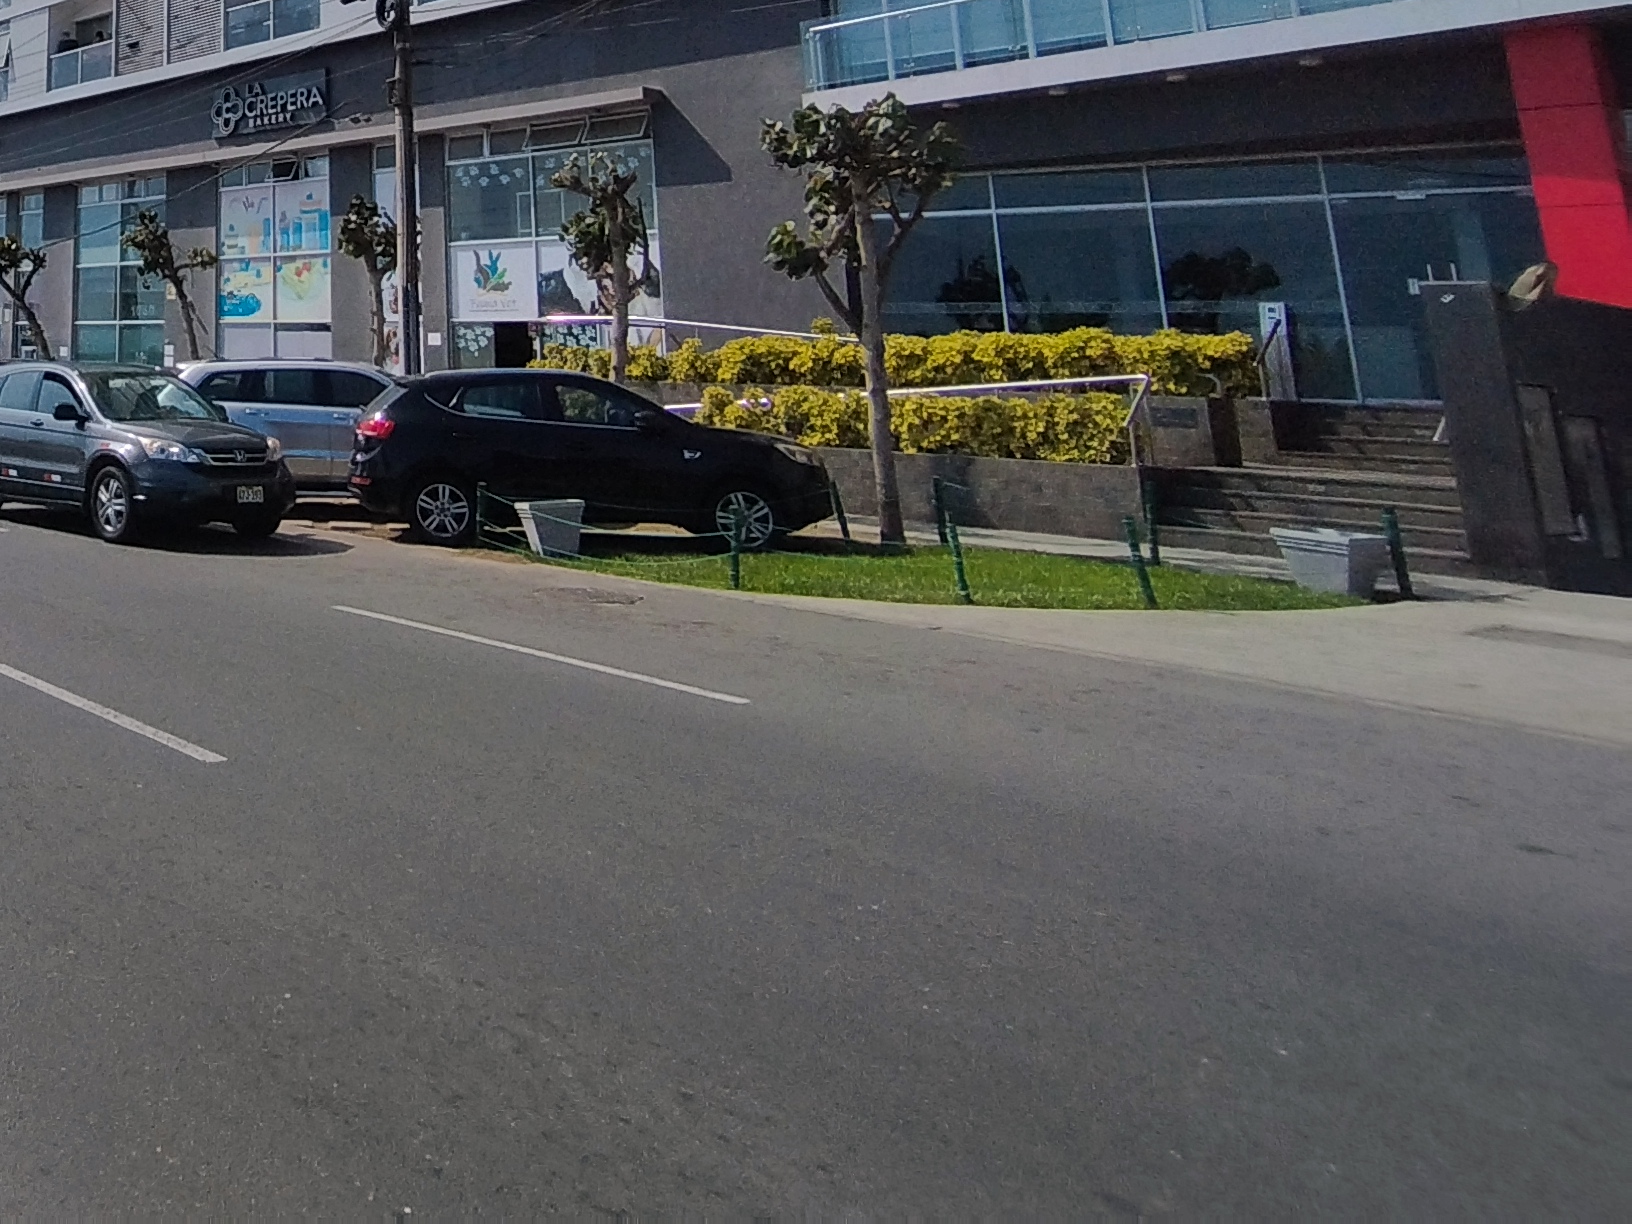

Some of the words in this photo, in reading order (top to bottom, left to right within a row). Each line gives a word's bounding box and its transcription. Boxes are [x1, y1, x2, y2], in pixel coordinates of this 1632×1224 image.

[245, 82, 262, 97] LA
[244, 86, 323, 116] CREPERA
[248, 112, 291, 128] BAKERY
